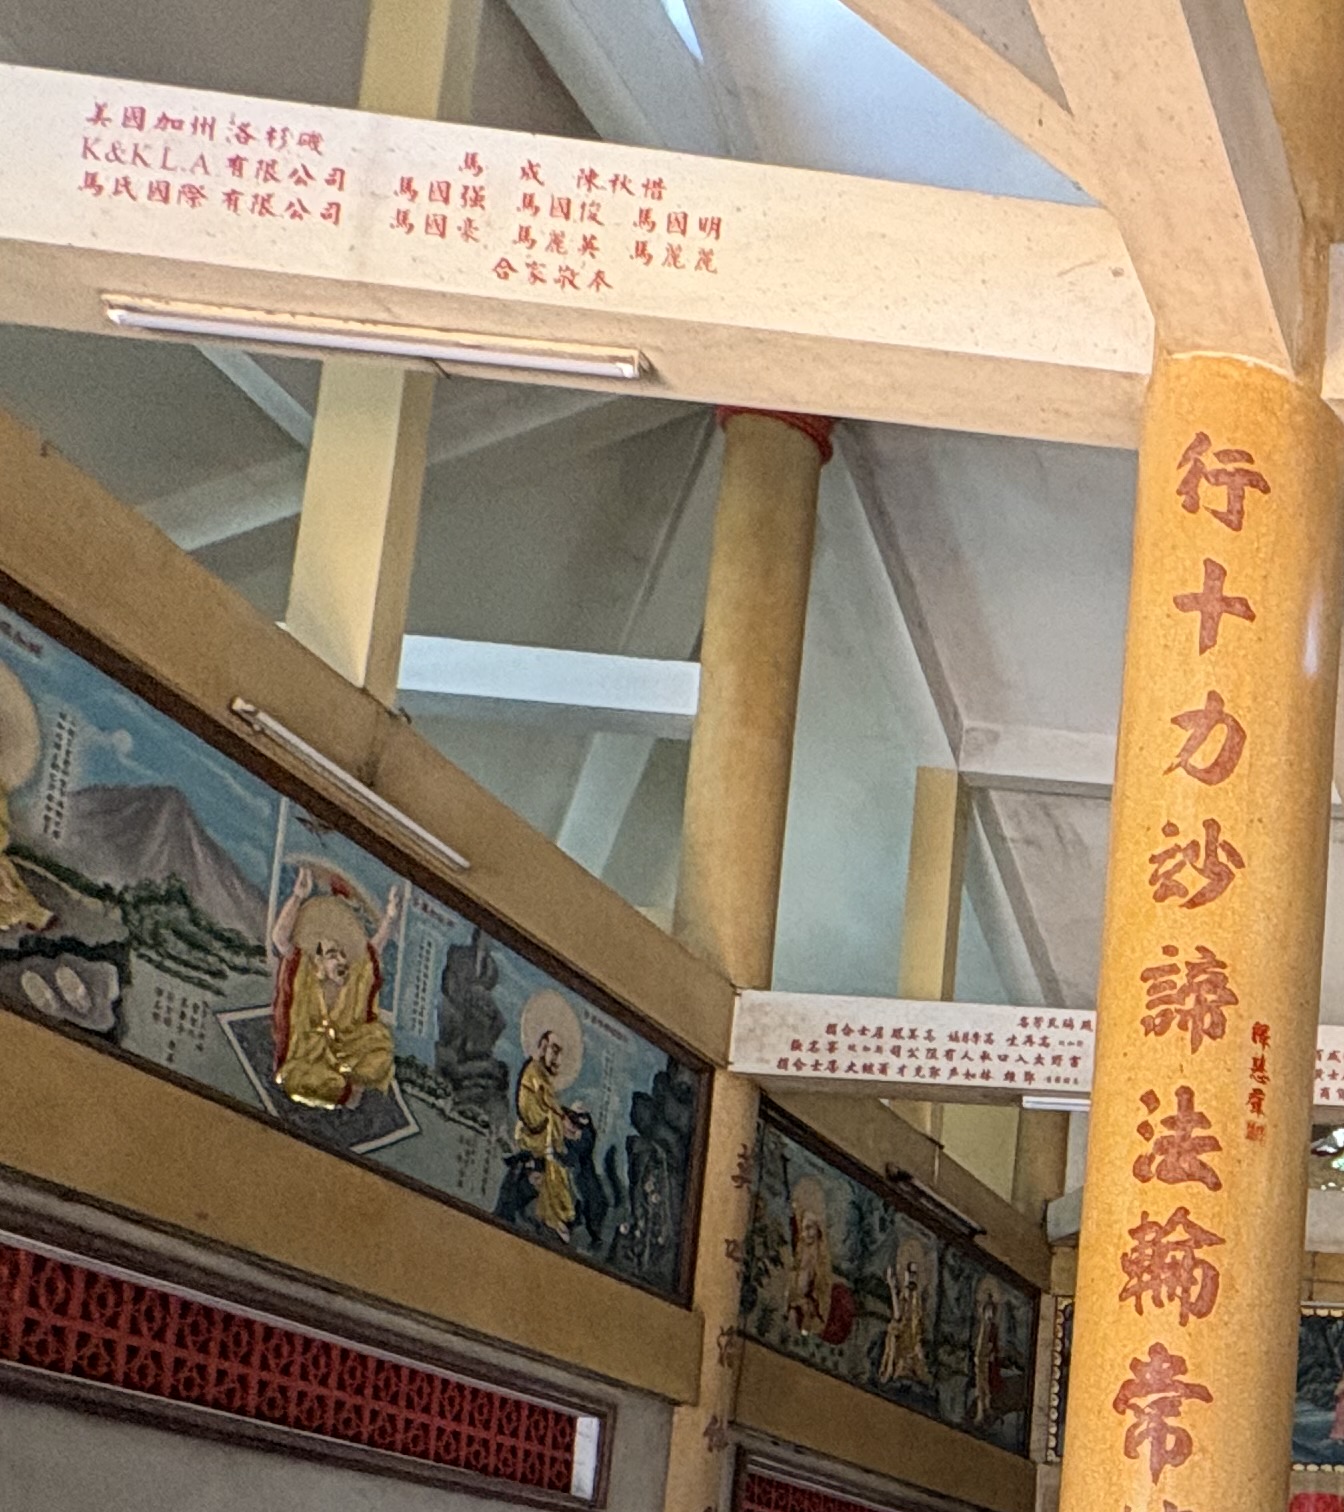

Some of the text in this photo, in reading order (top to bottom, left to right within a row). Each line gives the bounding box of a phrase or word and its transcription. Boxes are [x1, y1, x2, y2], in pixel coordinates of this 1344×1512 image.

[227, 153, 346, 192] 有限公司
[222, 188, 342, 226] 有限公司
[632, 206, 723, 241] 馬國明
